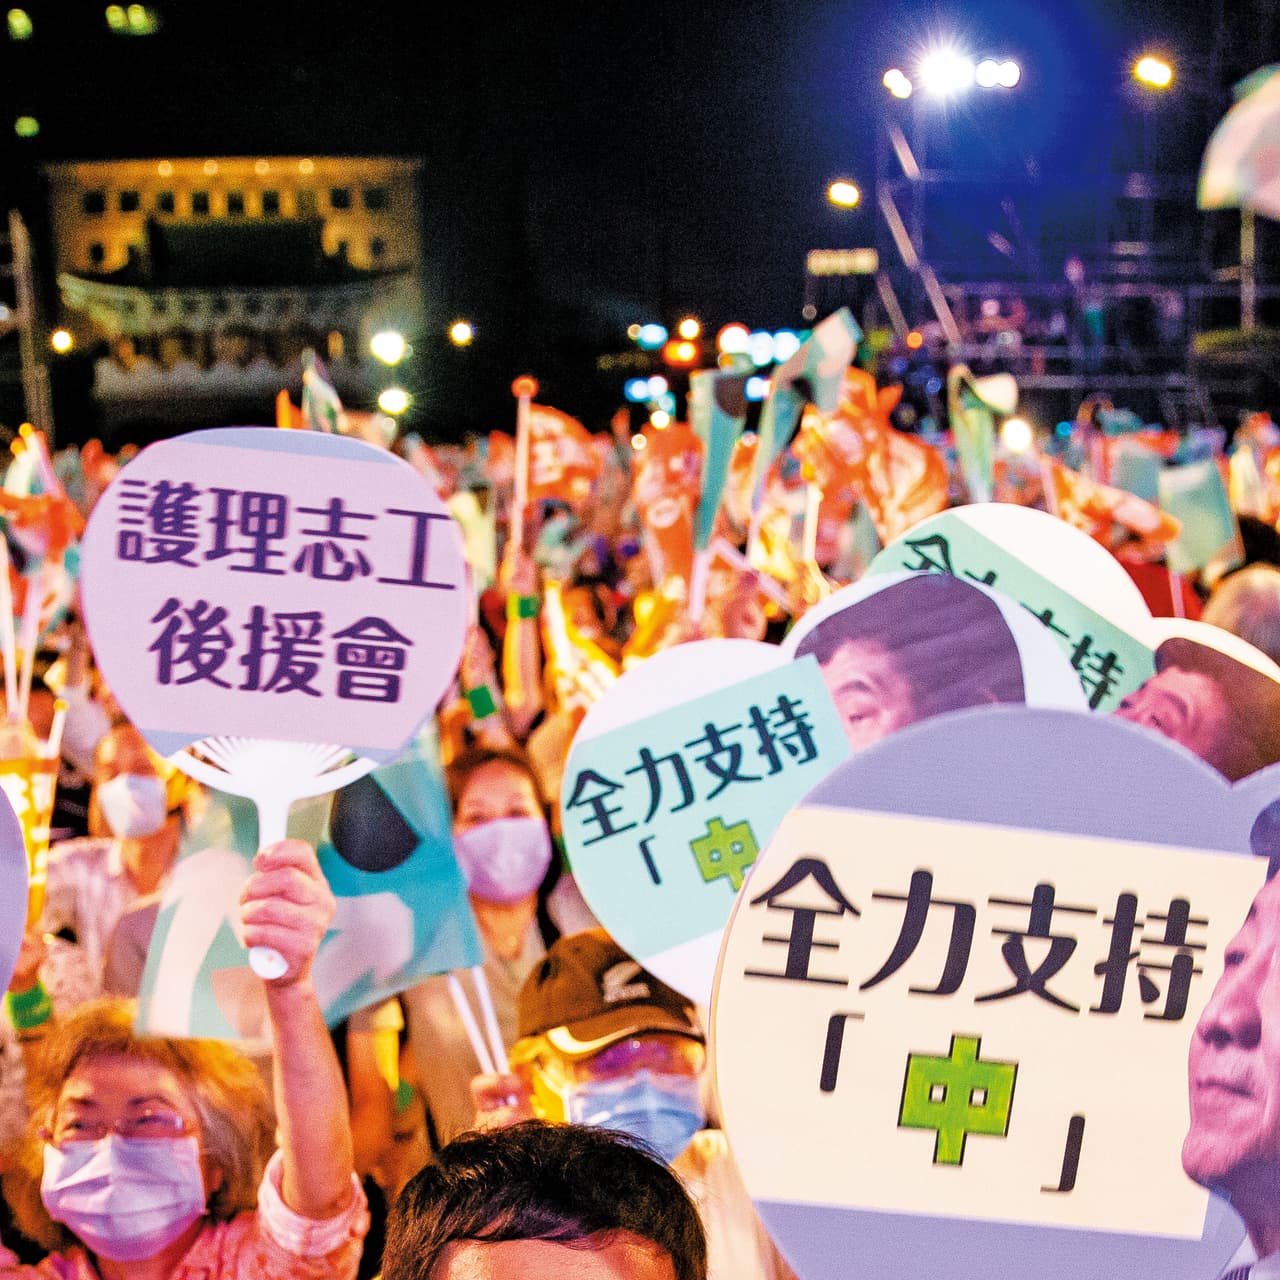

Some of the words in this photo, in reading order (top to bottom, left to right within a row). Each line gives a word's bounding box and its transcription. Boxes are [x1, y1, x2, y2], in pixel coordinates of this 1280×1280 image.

[117, 478, 457, 591] 護理志工
[147, 597, 415, 704] 後援會
[566, 694, 818, 846] 全力支持
[743, 857, 1210, 1021] 全力支持
